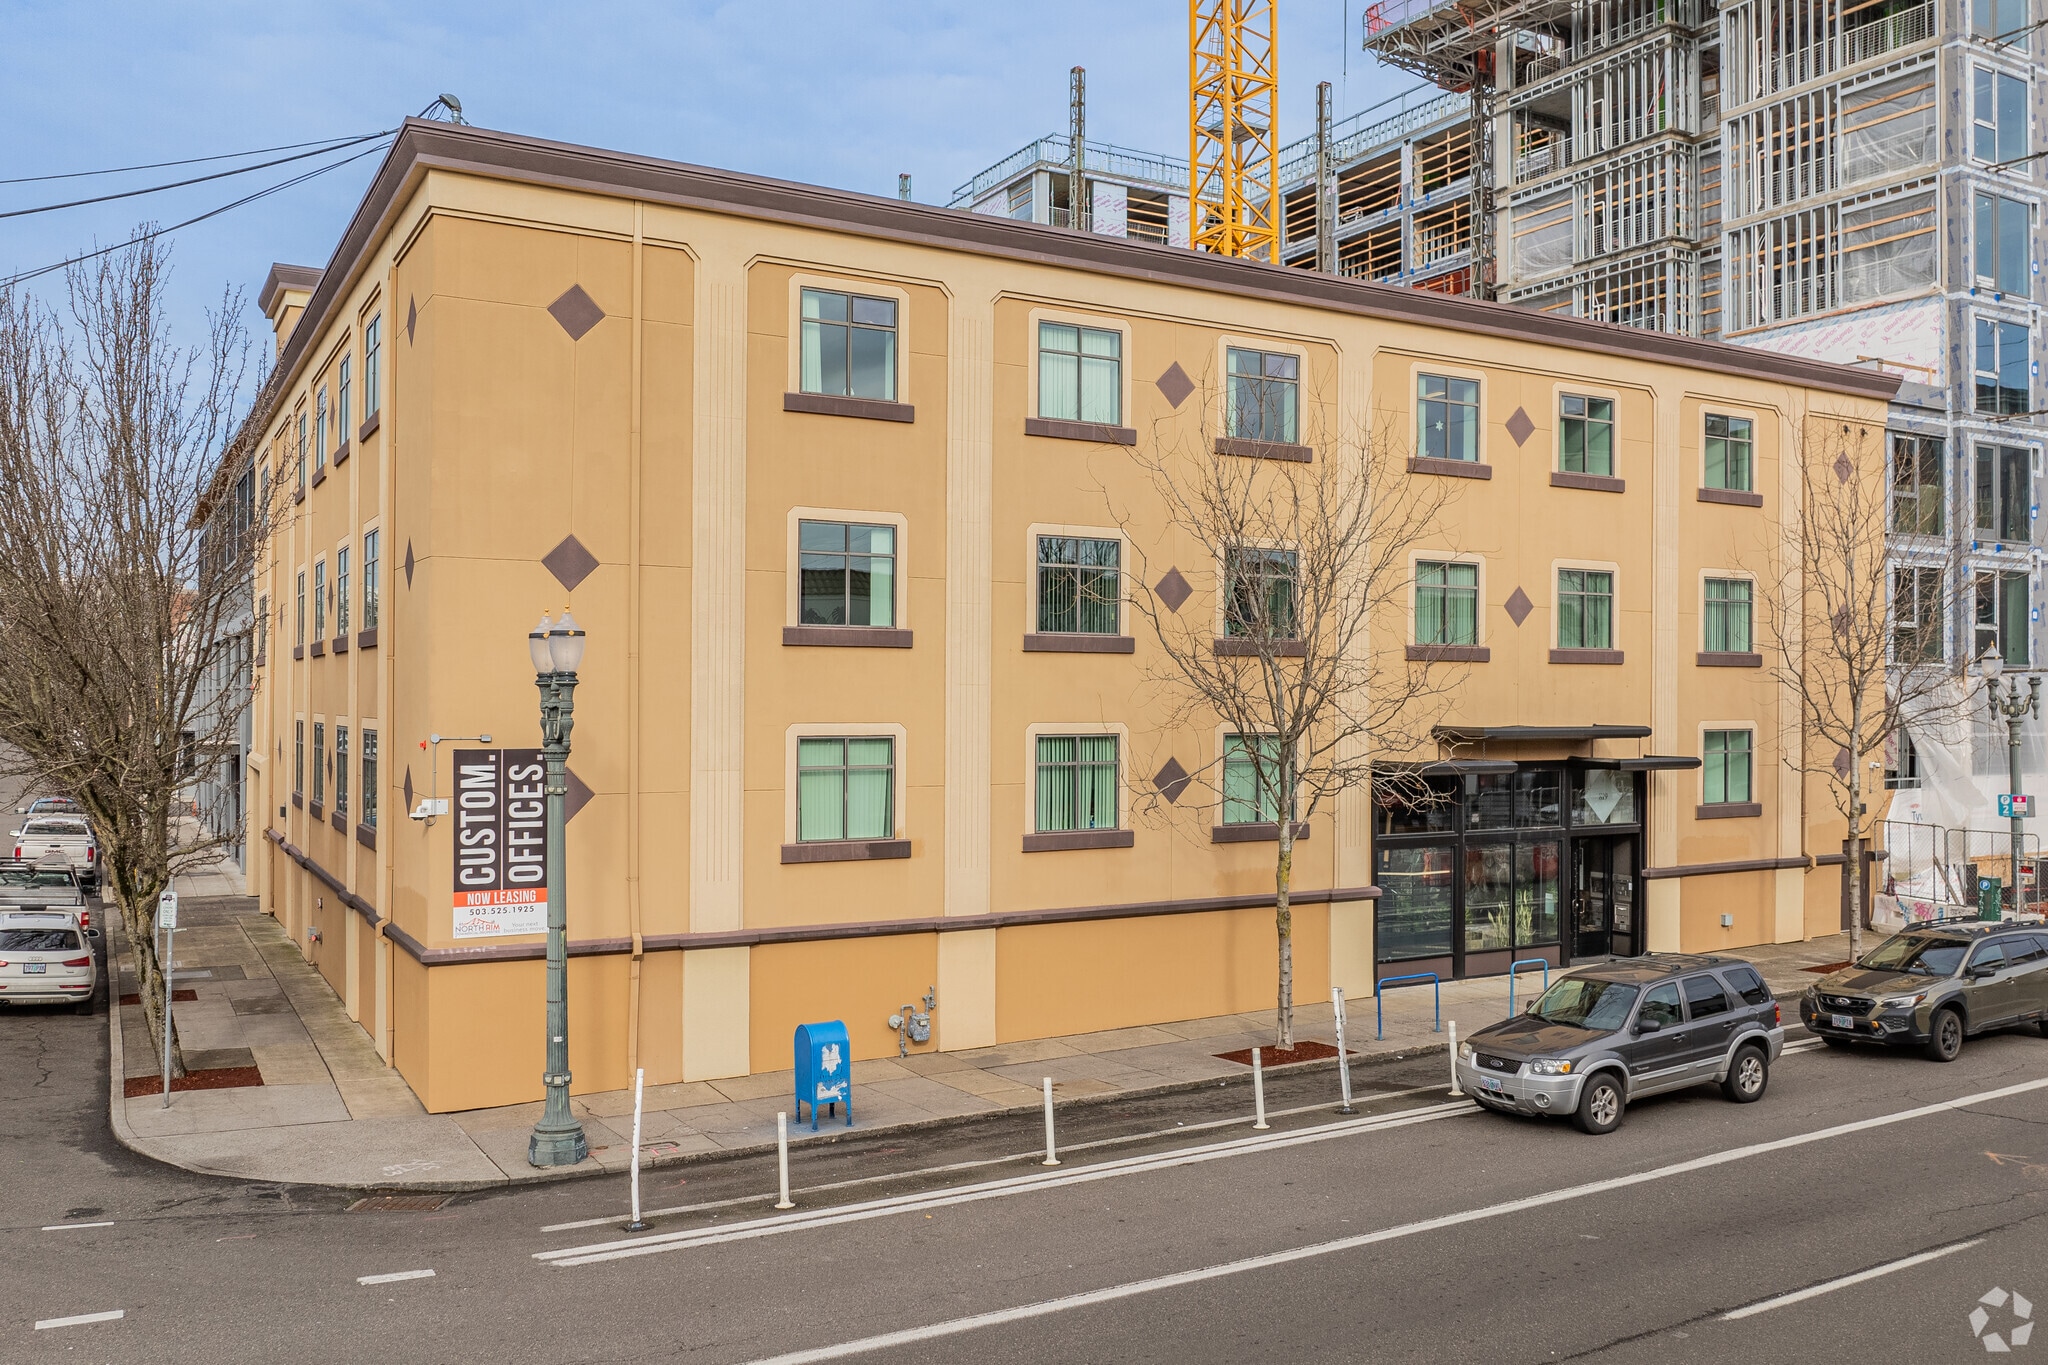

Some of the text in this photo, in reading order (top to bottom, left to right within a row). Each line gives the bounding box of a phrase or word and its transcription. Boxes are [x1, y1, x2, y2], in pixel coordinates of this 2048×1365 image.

[2002, 805, 2009, 814] 2
[460, 754, 496, 885] CUSTOM.
[508, 754, 544, 882] OFFICES.
[467, 889, 537, 906] NOW LEASING
[469, 905, 535, 916] 503.525.1925
[455, 924, 484, 933] NORTH
